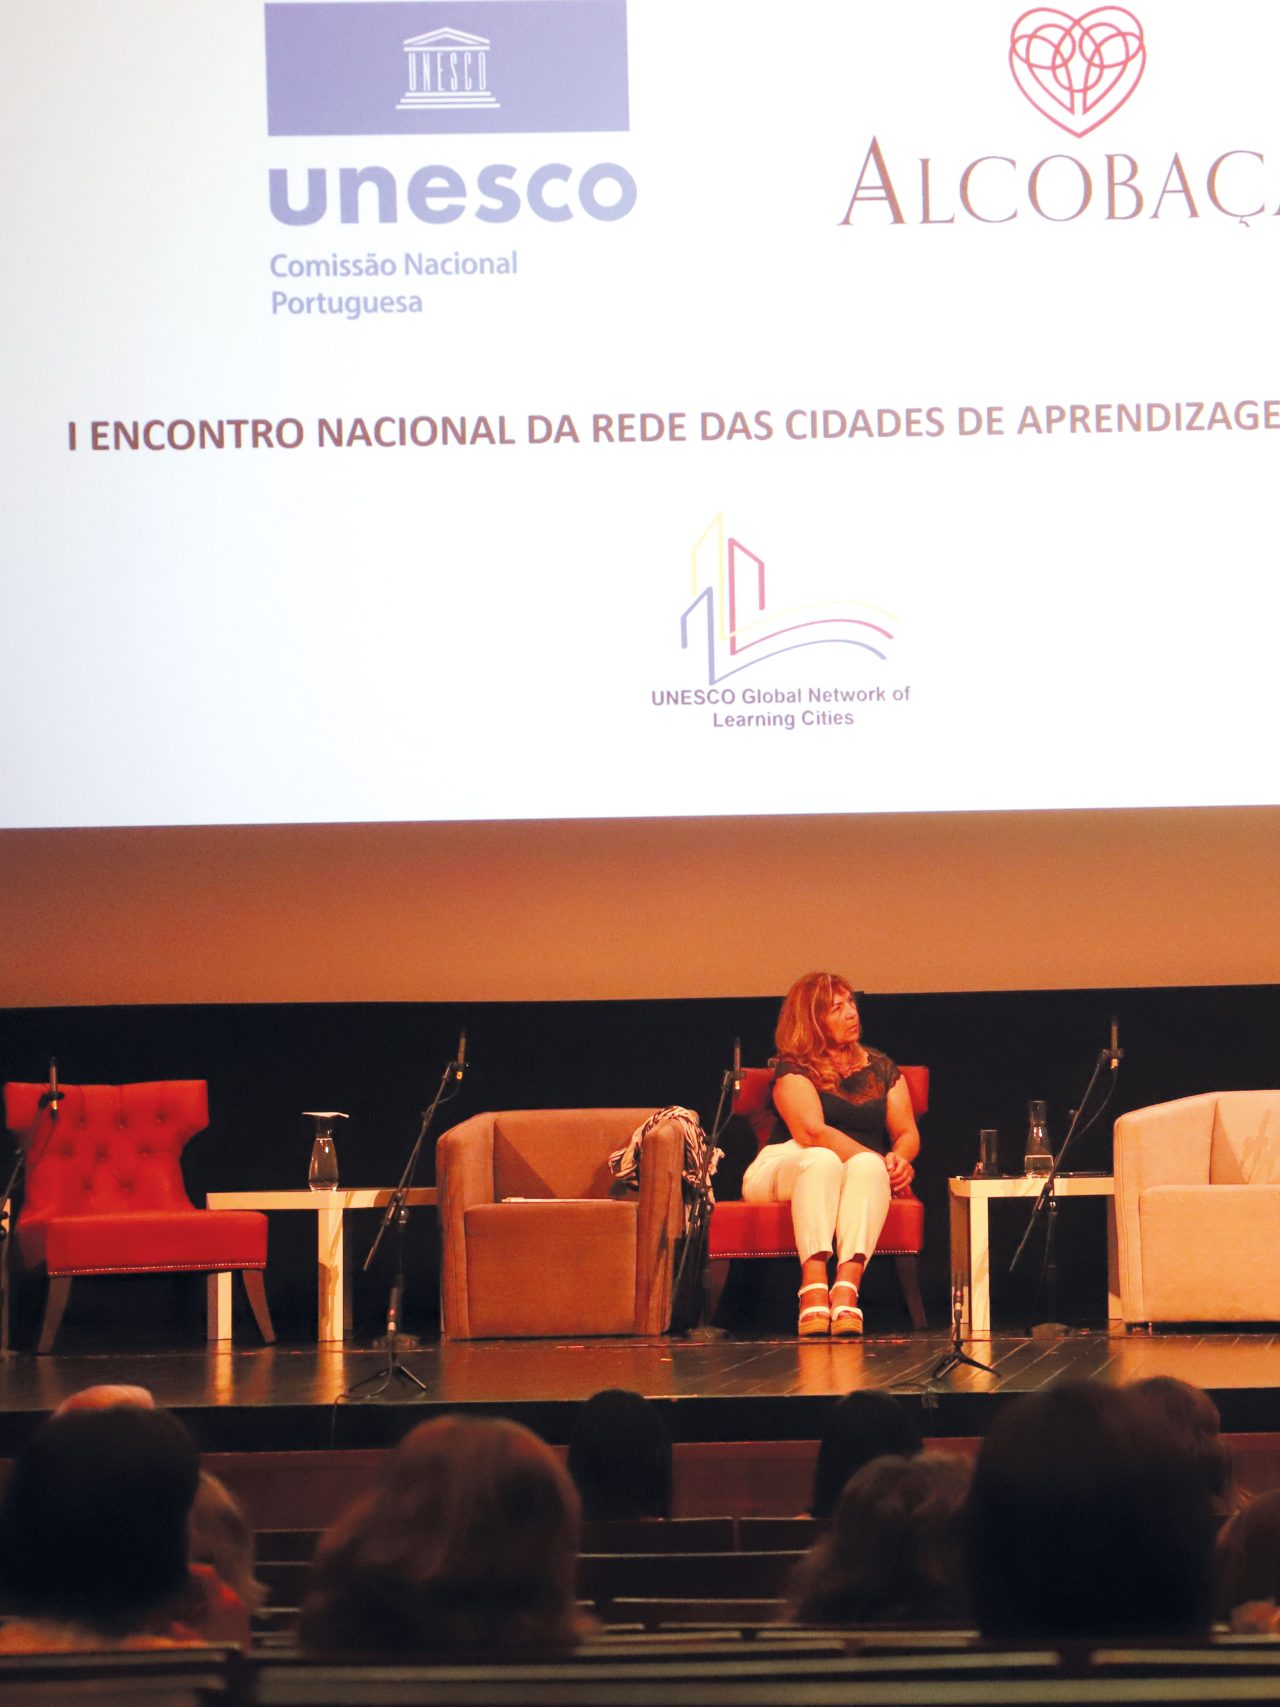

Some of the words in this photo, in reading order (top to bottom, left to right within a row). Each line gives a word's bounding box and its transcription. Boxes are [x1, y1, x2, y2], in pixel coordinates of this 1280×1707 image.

[408, 51, 487, 92] UNESCO
[269, 162, 638, 227] unesco
[269, 252, 397, 278] Comissão
[404, 250, 518, 276] Nacional
[271, 290, 423, 321] Portuguesa
[67, 420, 77, 452] I
[90, 417, 305, 452] ENCONTRO
[317, 415, 516, 448] NACIONAL
[527, 414, 580, 444] DA
[592, 412, 687, 443] REDE
[700, 410, 774, 441] DAS
[785, 406, 945, 440] CIDADES
[958, 406, 1004, 436] DE
[651, 689, 736, 706] UNESCO
[741, 687, 802, 705] Global
[808, 686, 886, 703] Network
[892, 685, 911, 702] of
[712, 711, 796, 730] Learning
[801, 709, 855, 726] Cities
